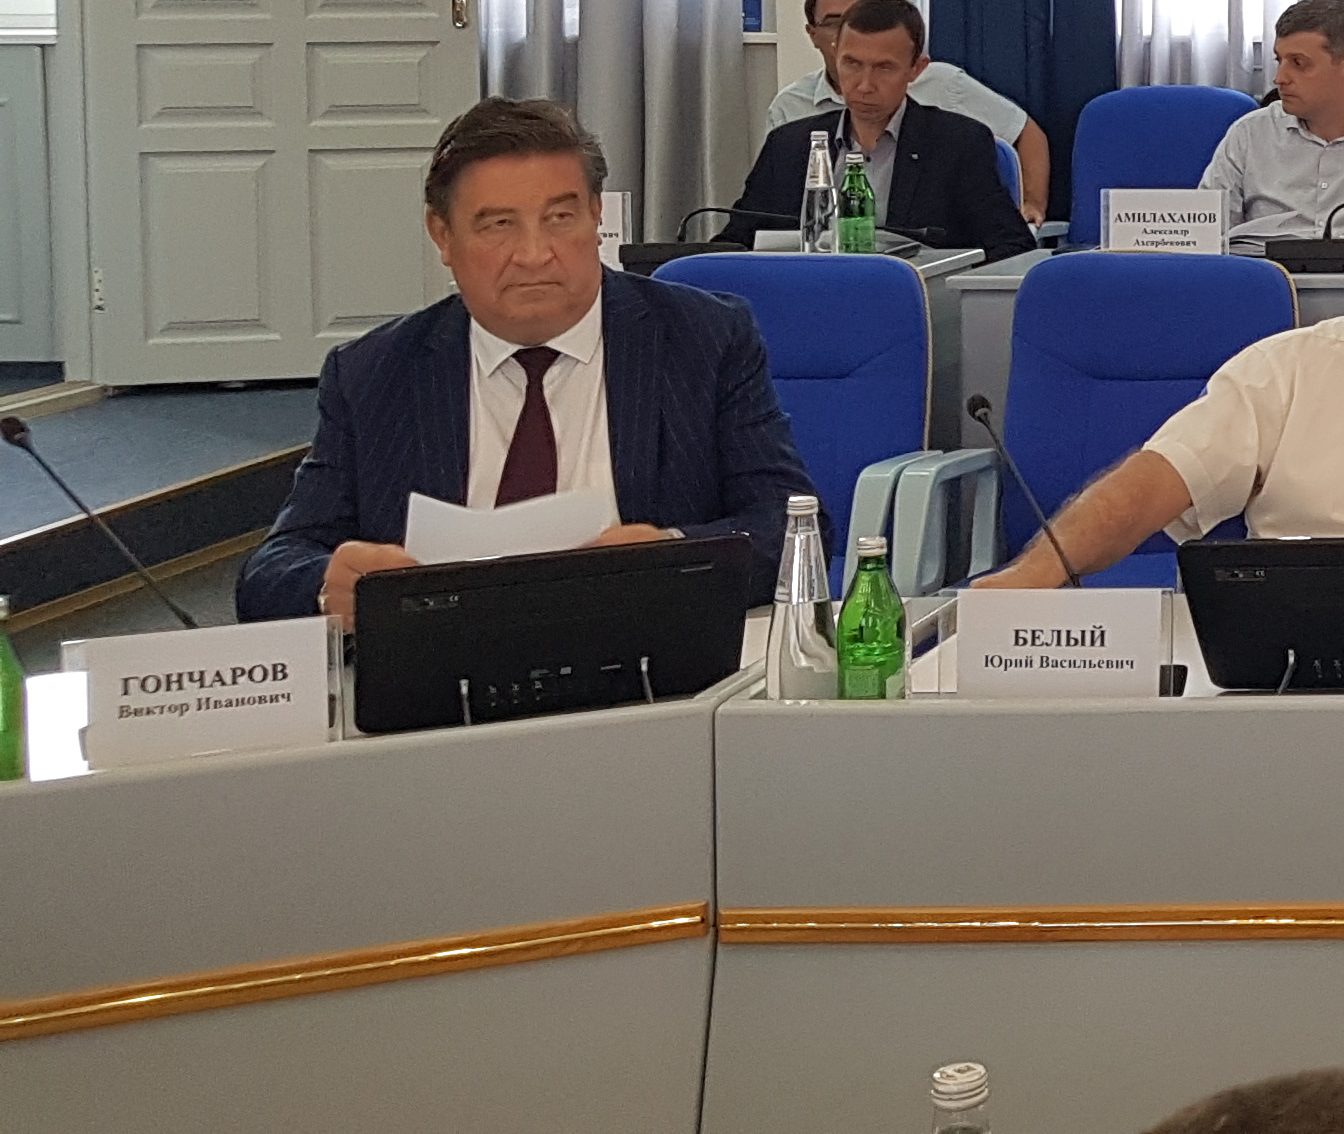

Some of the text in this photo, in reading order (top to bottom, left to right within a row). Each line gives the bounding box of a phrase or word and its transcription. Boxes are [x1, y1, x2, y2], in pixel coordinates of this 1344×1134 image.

[1114, 212, 1217, 223] АМИЛАХАНОВ
[1012, 624, 1107, 648] БЕЛЫЙ
[984, 654, 1135, 671] Юрий Васильевич
[120, 662, 289, 697] ГОНЧАРОВ
[117, 692, 292, 719] Виктор Иванович
